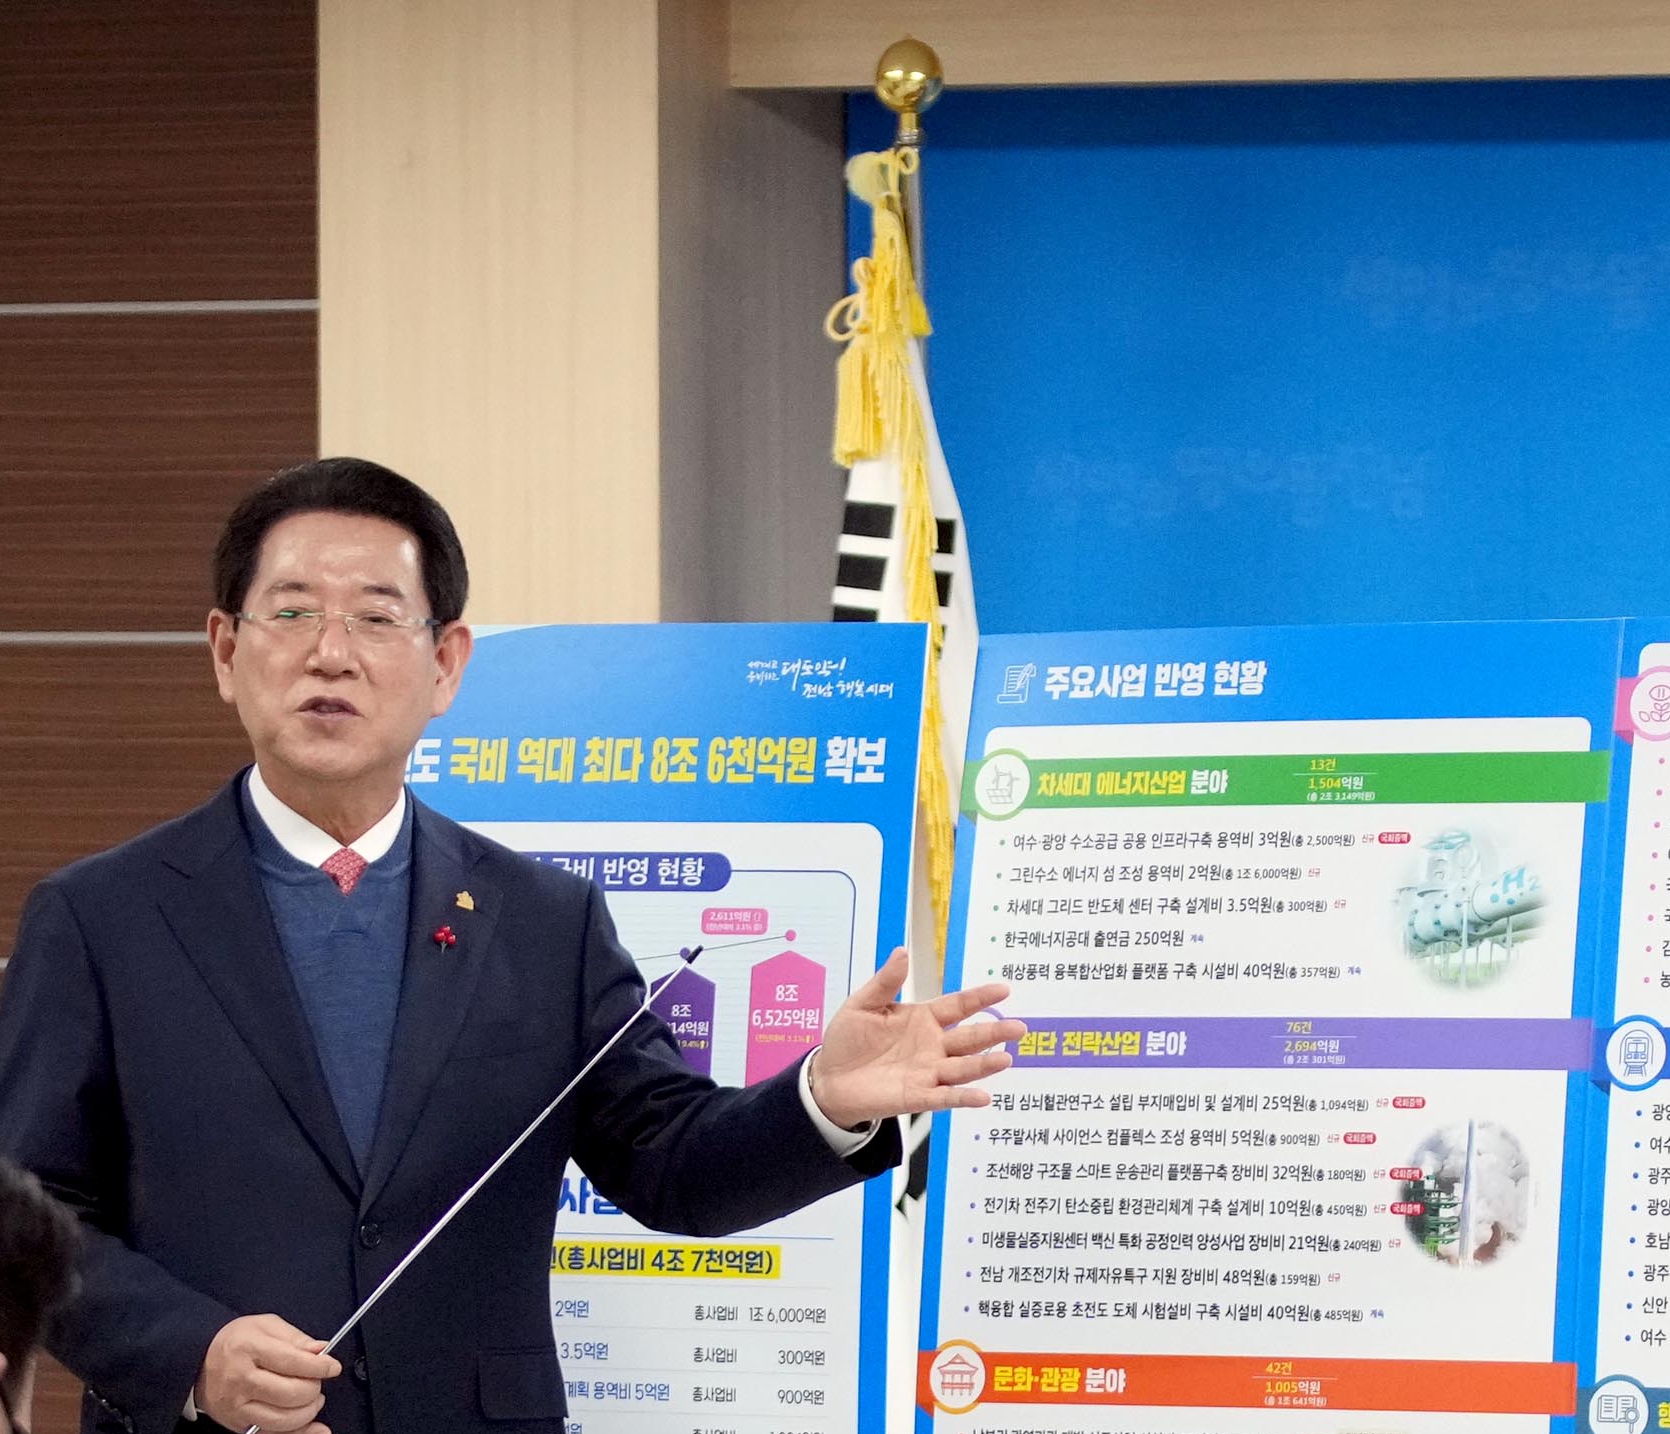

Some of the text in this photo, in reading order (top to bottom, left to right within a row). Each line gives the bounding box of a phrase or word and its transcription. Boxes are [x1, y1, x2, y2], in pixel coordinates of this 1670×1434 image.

[1045, 660, 1267, 700] 주요사업 반영 현황
[451, 737, 507, 783] 국비
[517, 737, 575, 783] 역대
[584, 737, 644, 783] 최다
[652, 737, 699, 783] 8조
[709, 737, 815, 783] 6천억원
[827, 737, 886, 783] 확보
[1310, 758, 1336, 771] 13건
[1038, 769, 1228, 797] 차세대 에너지산업 분야
[1309, 776, 1363, 790] 1,504억원
[1014, 834, 1066, 851] 여수·광양
[1070, 834, 1118, 850] 수소공급
[1123, 833, 1146, 849] 공용
[1152, 832, 1212, 849] 인프라구축
[1217, 832, 1253, 848] 용역비
[604, 857, 649, 886] 반영
[659, 857, 705, 886] 현황
[1005, 931, 1089, 947] 한국에너지공대
[1094, 931, 1130, 947] 출연금
[1135, 931, 1184, 946] 250억원
[776, 985, 798, 1001] 8조
[672, 1005, 691, 1017] 8조
[753, 1009, 819, 1029] 6,525억원
[1286, 1020, 1312, 1033] 76건
[1063, 1031, 1141, 1056] 전략산업
[1146, 1030, 1186, 1056] 분야
[1284, 1039, 1339, 1053] 2,694억원
[989, 1129, 1049, 1145] 우주발사체
[1053, 1129, 1102, 1145] 사이언스
[1107, 1129, 1155, 1145] 컴플렉스
[1160, 1130, 1185, 1146] 조성
[1190, 1129, 1226, 1146] 용역비
[651, 1250, 684, 1271] 4조
[692, 1250, 772, 1274] 7천억원)
[981, 1267, 1004, 1282] 전남
[1008, 1267, 1069, 1283] 개조전기차
[1074, 1267, 1147, 1284] 규제자유특구
[1153, 1268, 1176, 1284] 지원
[1181, 1268, 1218, 1285] 장비비
[555, 1301, 588, 1318] 2억원
[750, 1307, 763, 1321] 1조
[767, 1308, 826, 1323] 6,000억원
[561, 1343, 608, 1360] 3.5억원
[779, 1350, 825, 1365] 300억원
[1265, 1361, 1292, 1375] 42건
[994, 1367, 1126, 1393] 문화·관광 분야
[1265, 1380, 1321, 1394] 1,005억원
[594, 1382, 630, 1399] 용역비
[635, 1384, 669, 1401] 5억원
[778, 1390, 824, 1405] 900억원
